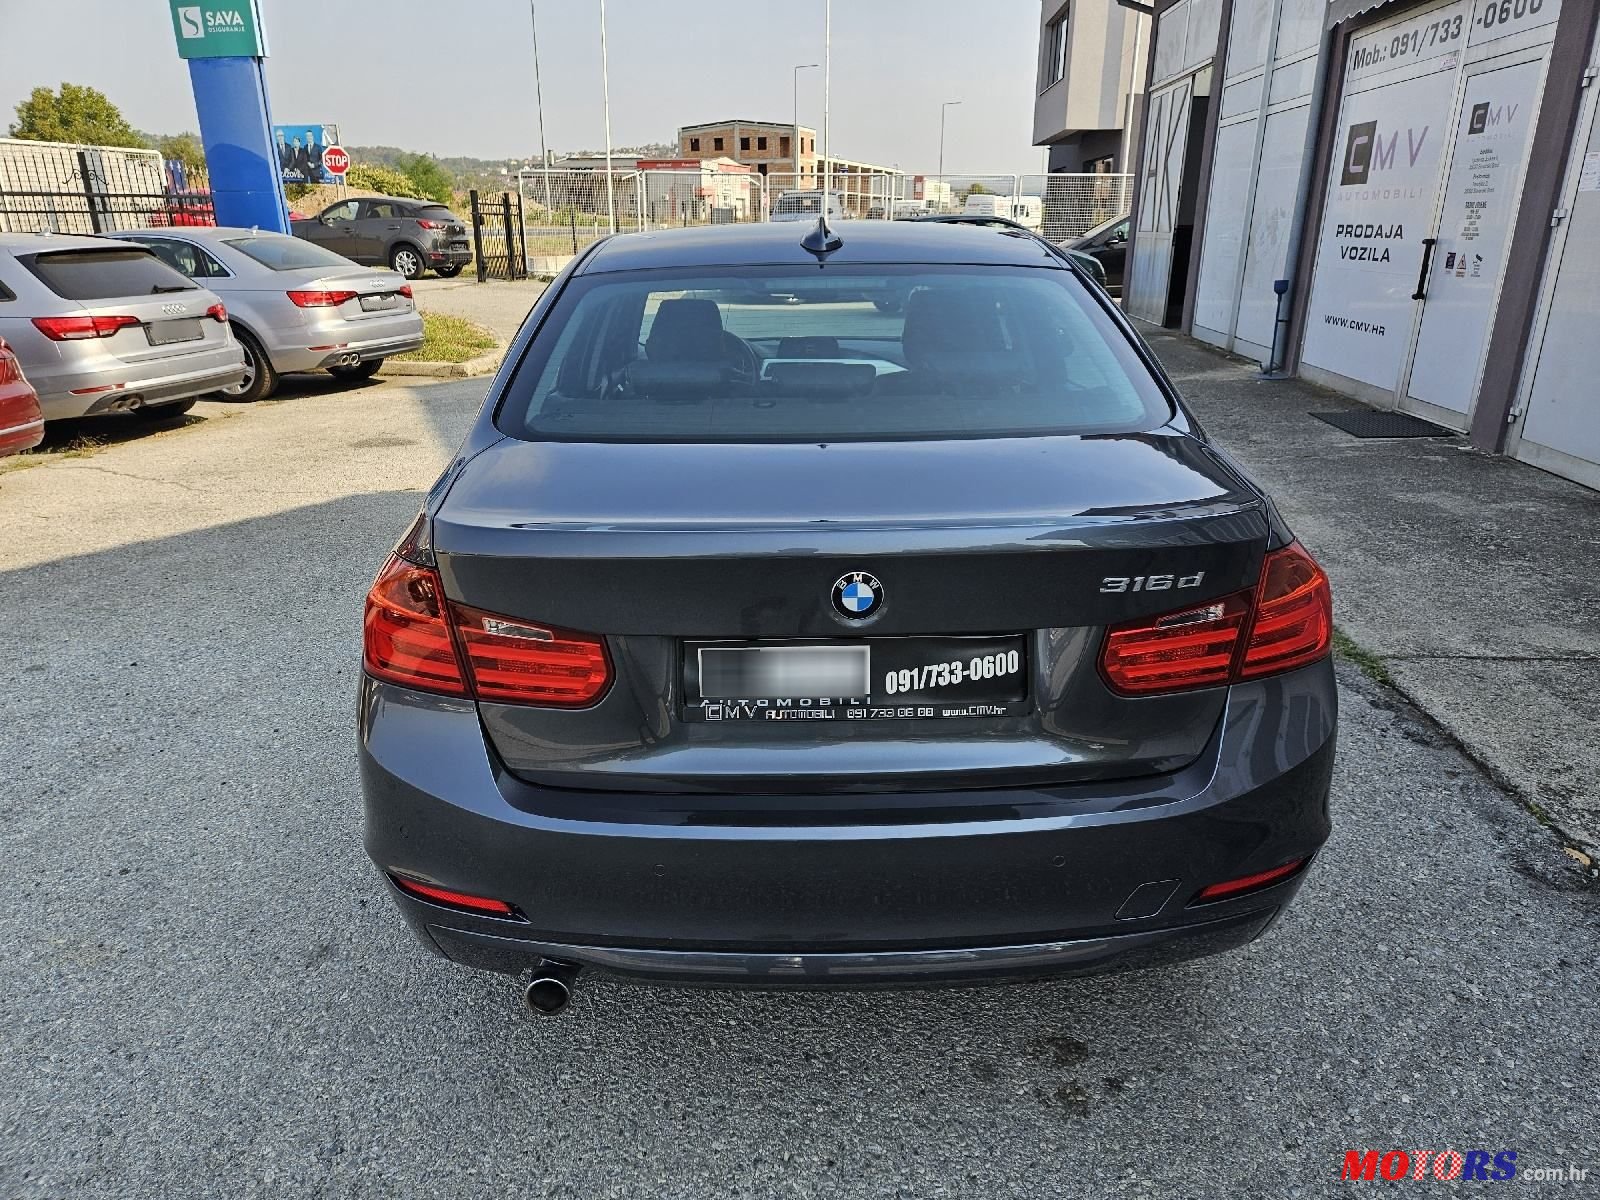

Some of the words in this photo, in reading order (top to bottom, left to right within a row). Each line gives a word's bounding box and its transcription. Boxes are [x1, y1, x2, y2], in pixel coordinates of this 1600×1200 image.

[205, 10, 244, 26] SAVA
[1389, 15, 1463, 58] 091/733
[1347, 125, 1430, 174] CMV
[325, 154, 348, 167] STOP
[1335, 224, 1404, 240] PRODAJA
[1340, 246, 1391, 263] VOZILA
[836, 572, 880, 590] BMW
[1100, 571, 1205, 593] 316d
[885, 649, 1019, 695] 091/733-0600
[706, 703, 758, 721] CMV
[765, 709, 835, 720] AUTOMOBILI
